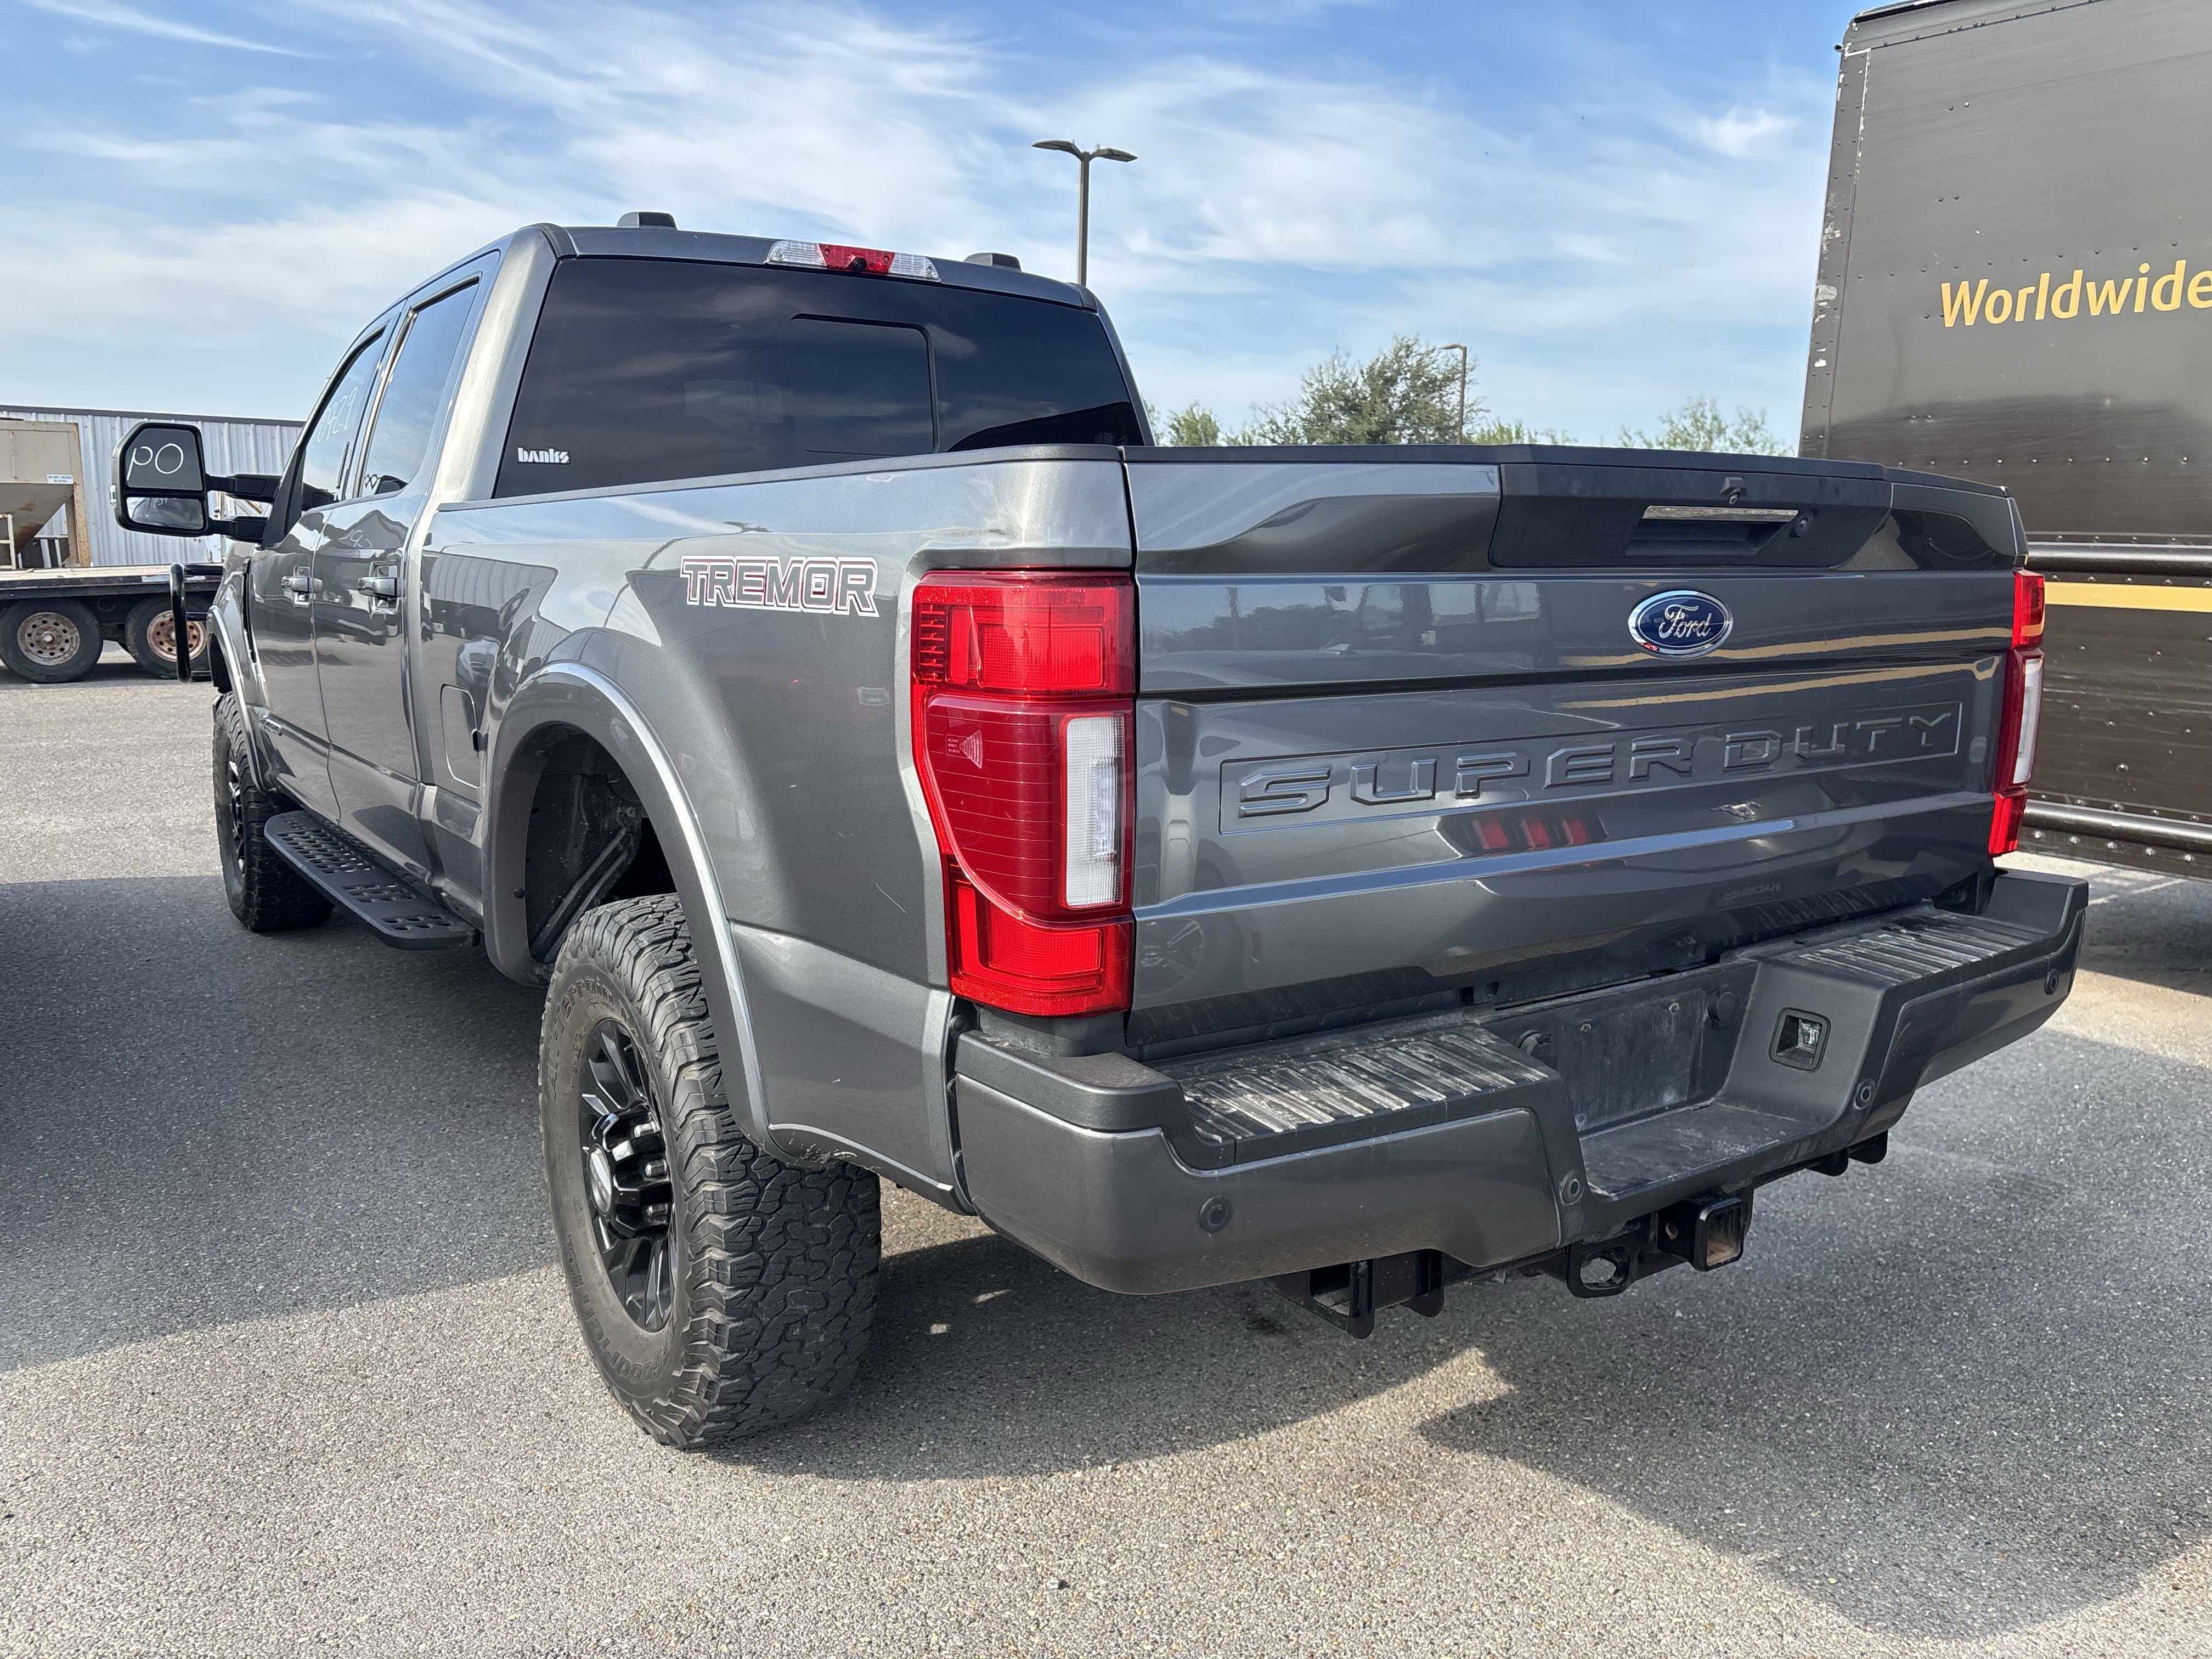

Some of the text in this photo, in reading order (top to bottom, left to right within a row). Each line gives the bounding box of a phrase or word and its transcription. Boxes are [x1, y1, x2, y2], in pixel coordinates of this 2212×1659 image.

[1940, 259, 2212, 328] Worldwide
[680, 555, 880, 617] TREMOR
[1658, 604, 1712, 639] Ford
[1238, 712, 1952, 819] SUPER DUTY
